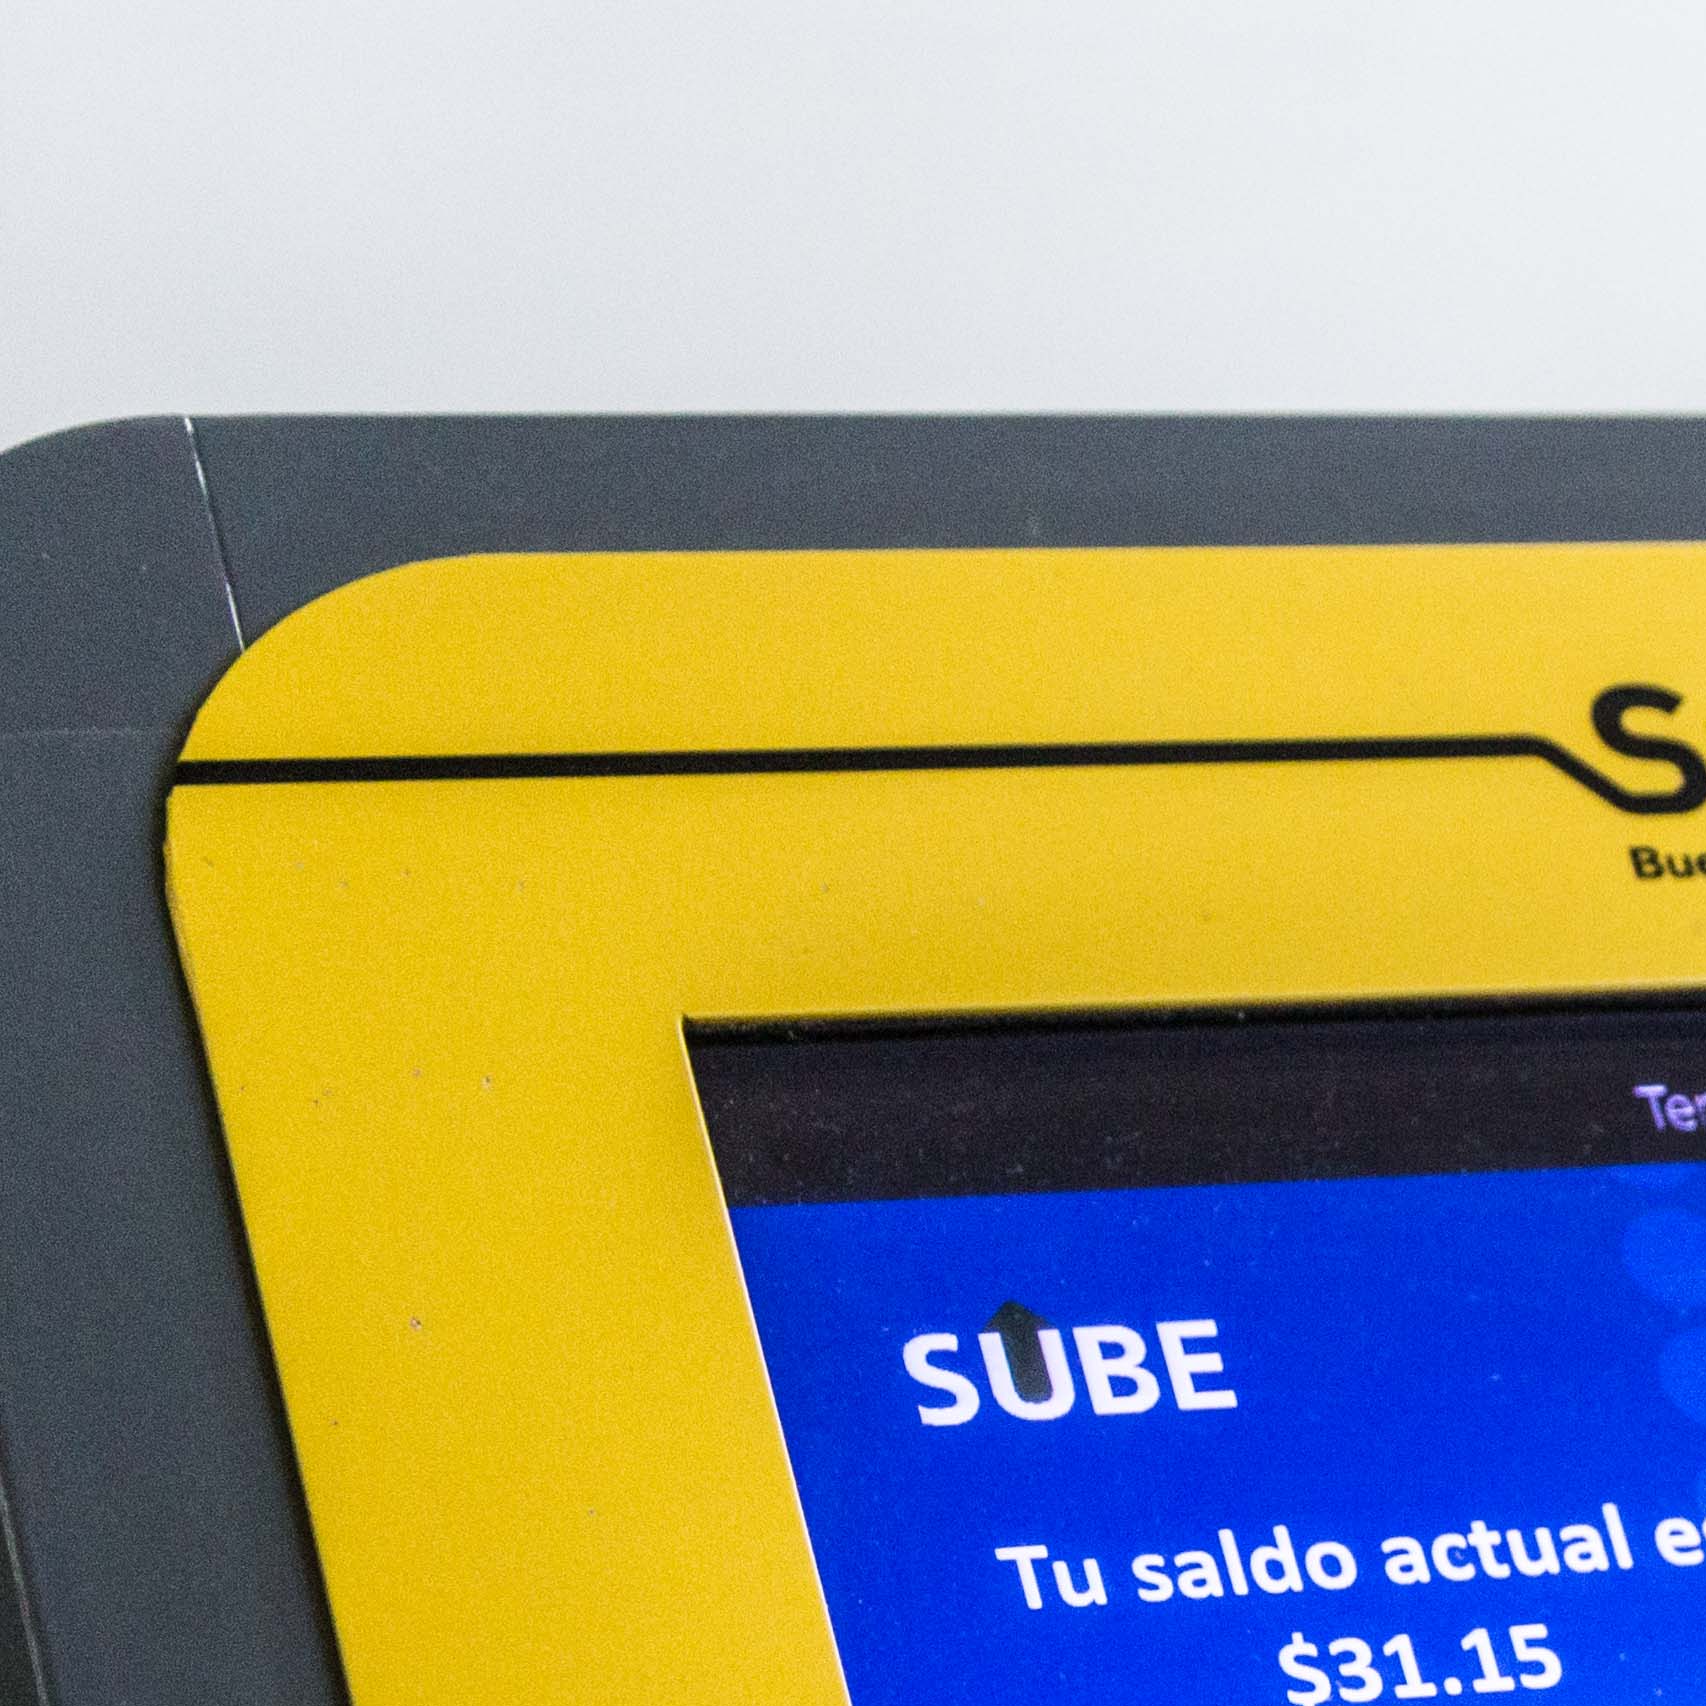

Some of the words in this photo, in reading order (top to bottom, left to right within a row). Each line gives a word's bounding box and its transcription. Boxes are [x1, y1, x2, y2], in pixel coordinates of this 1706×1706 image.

[901, 1318, 1238, 1427] SUBE
[994, 1544, 1108, 1611] Tu
[1131, 1523, 1358, 1602] saldo
[1381, 1501, 1633, 1586] actual
